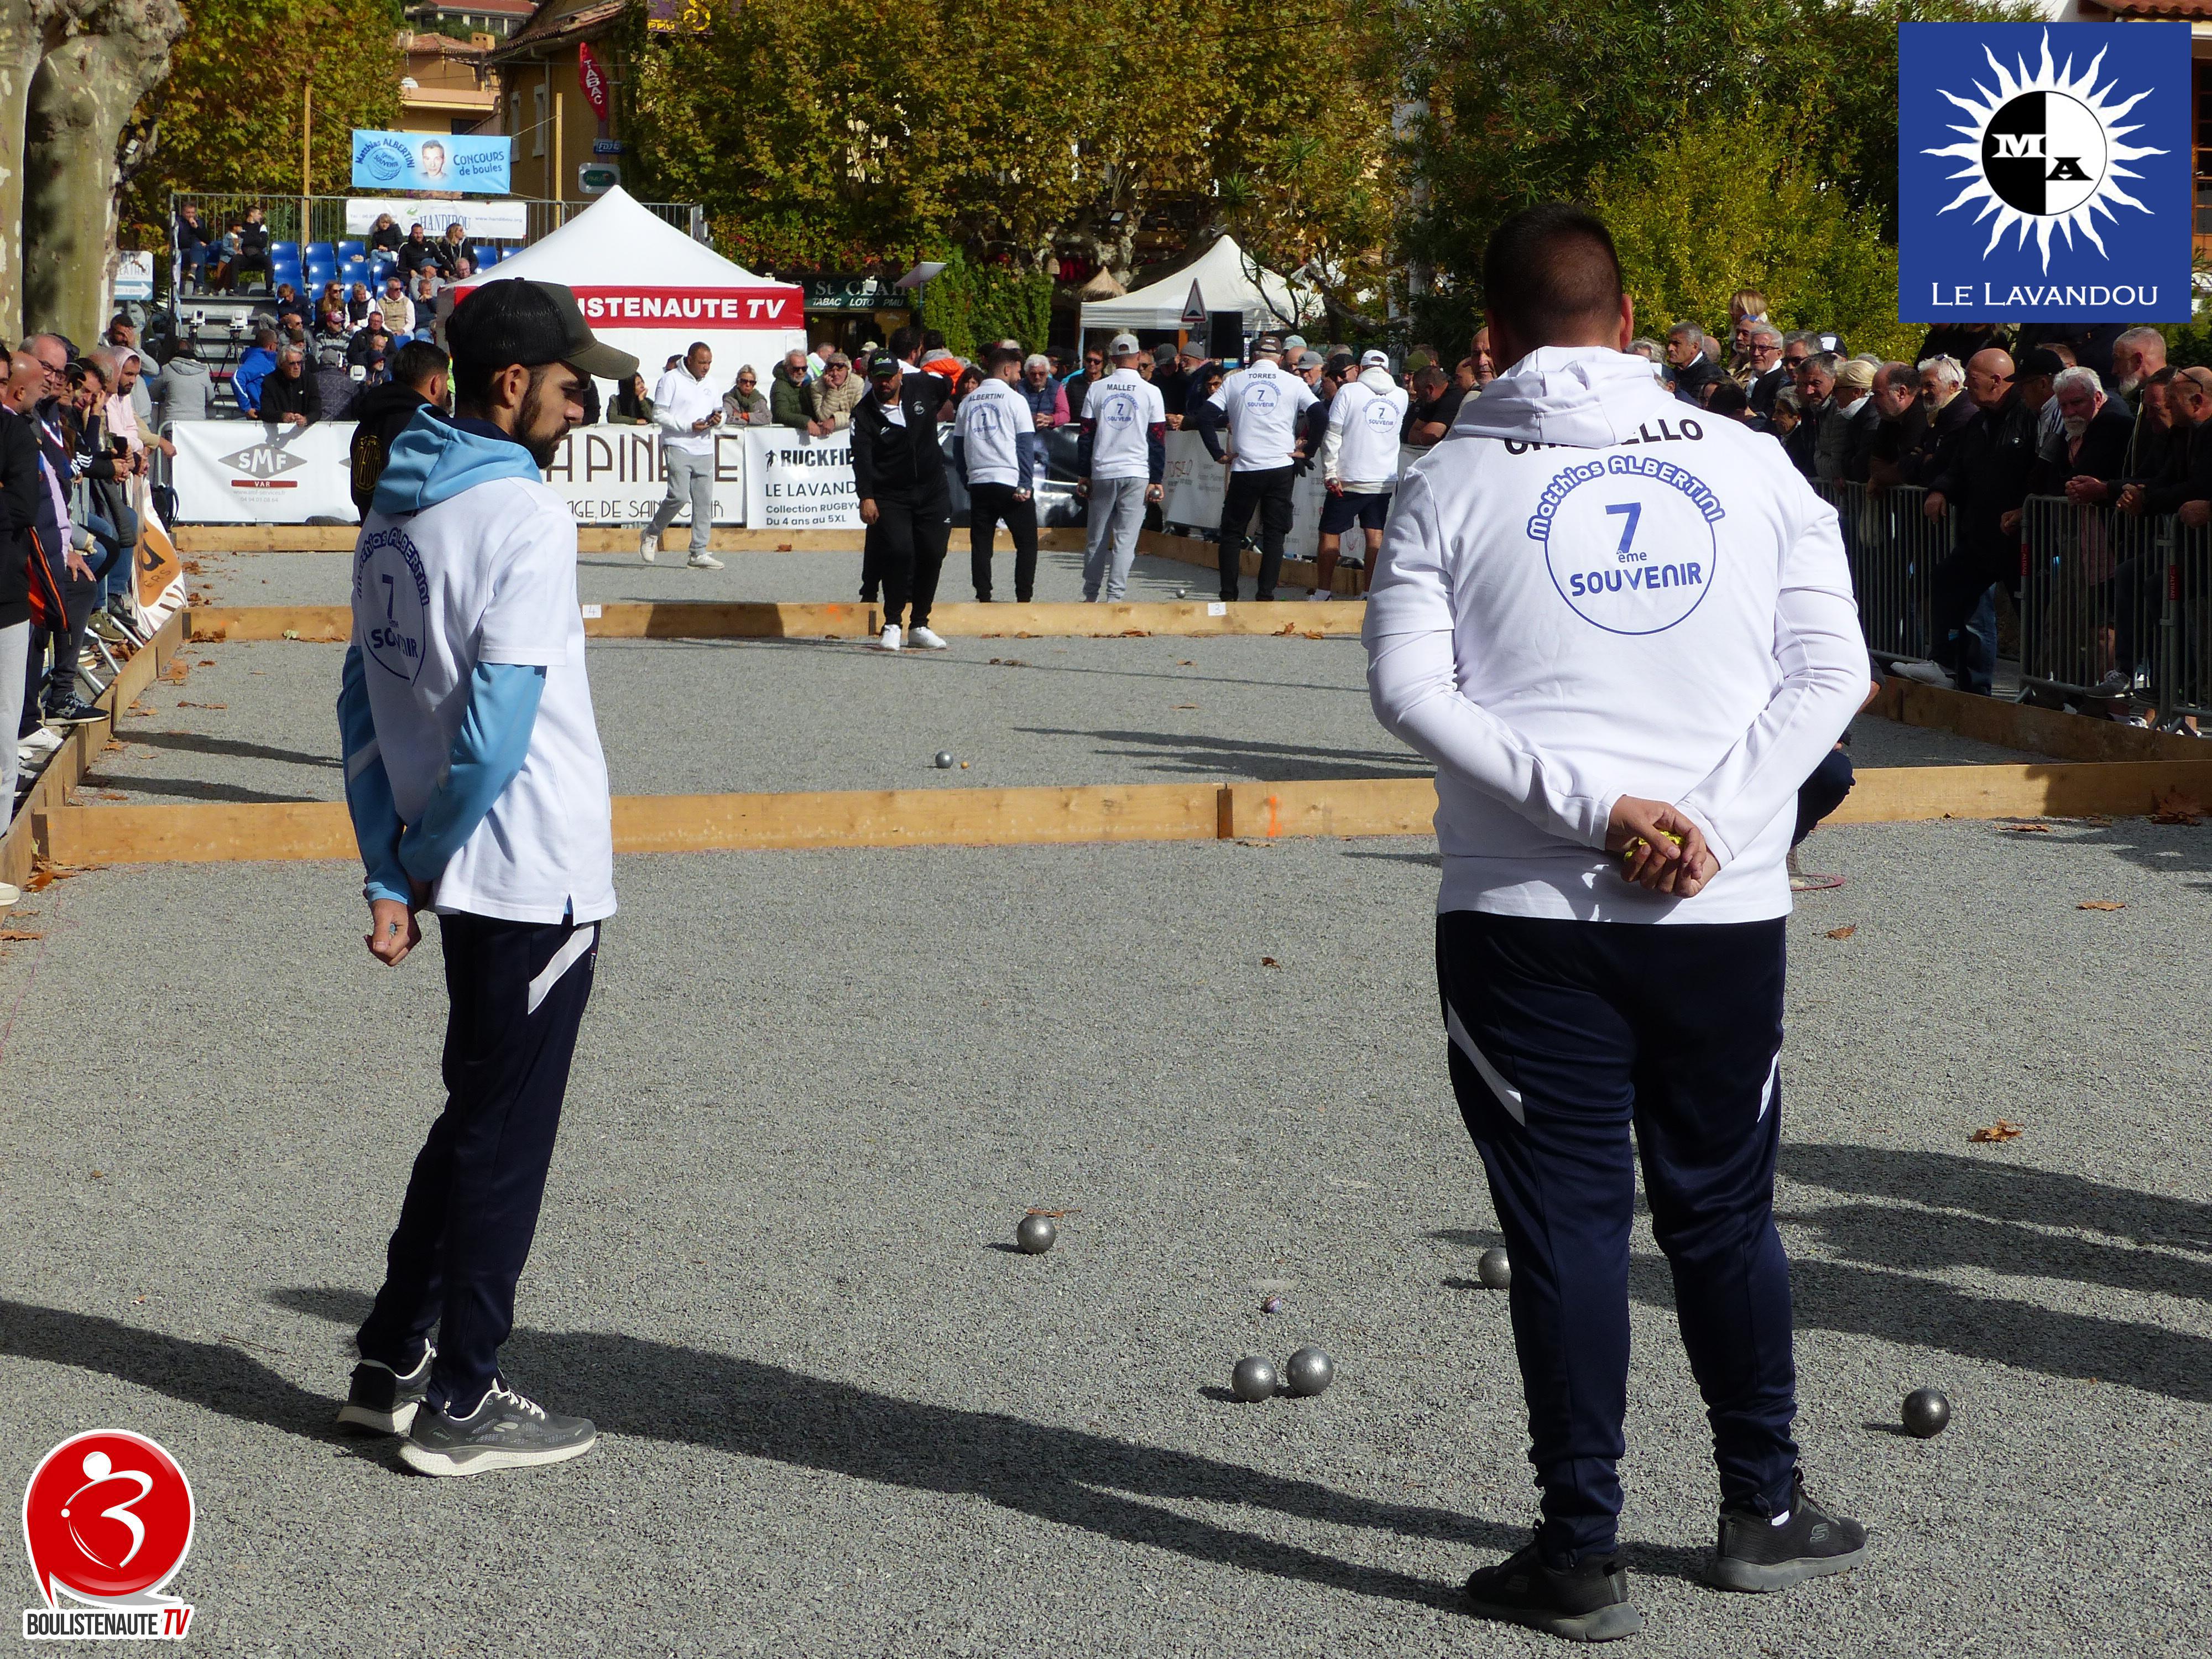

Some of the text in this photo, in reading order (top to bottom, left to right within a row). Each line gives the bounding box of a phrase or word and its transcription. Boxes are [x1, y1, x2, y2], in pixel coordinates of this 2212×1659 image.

[584, 59, 603, 105] TABAC
[383, 138, 415, 168] ALBERTINI
[453, 150, 505, 165] CONCOURS
[459, 164, 502, 176] de boules
[815, 281, 834, 295] St
[747, 299, 786, 319] TV
[812, 298, 842, 306] TABAC
[968, 393, 1005, 402] ALBERTINI
[238, 448, 286, 473] SMF
[766, 484, 781, 497] LE
[1608, 455, 1725, 523] ALBERTINI
[602, 501, 622, 518] DE
[766, 504, 817, 513] Collection
[828, 514, 846, 523] 5XL
[1605, 502, 1641, 554] 7
[1618, 550, 1647, 563] ème
[388, 526, 430, 606] ALBERTINI
[1570, 562, 1702, 597] SOUVENIR
[382, 573, 394, 619] 7
[588, 606, 597, 616] 4
[1214, 603, 1222, 614] 3
